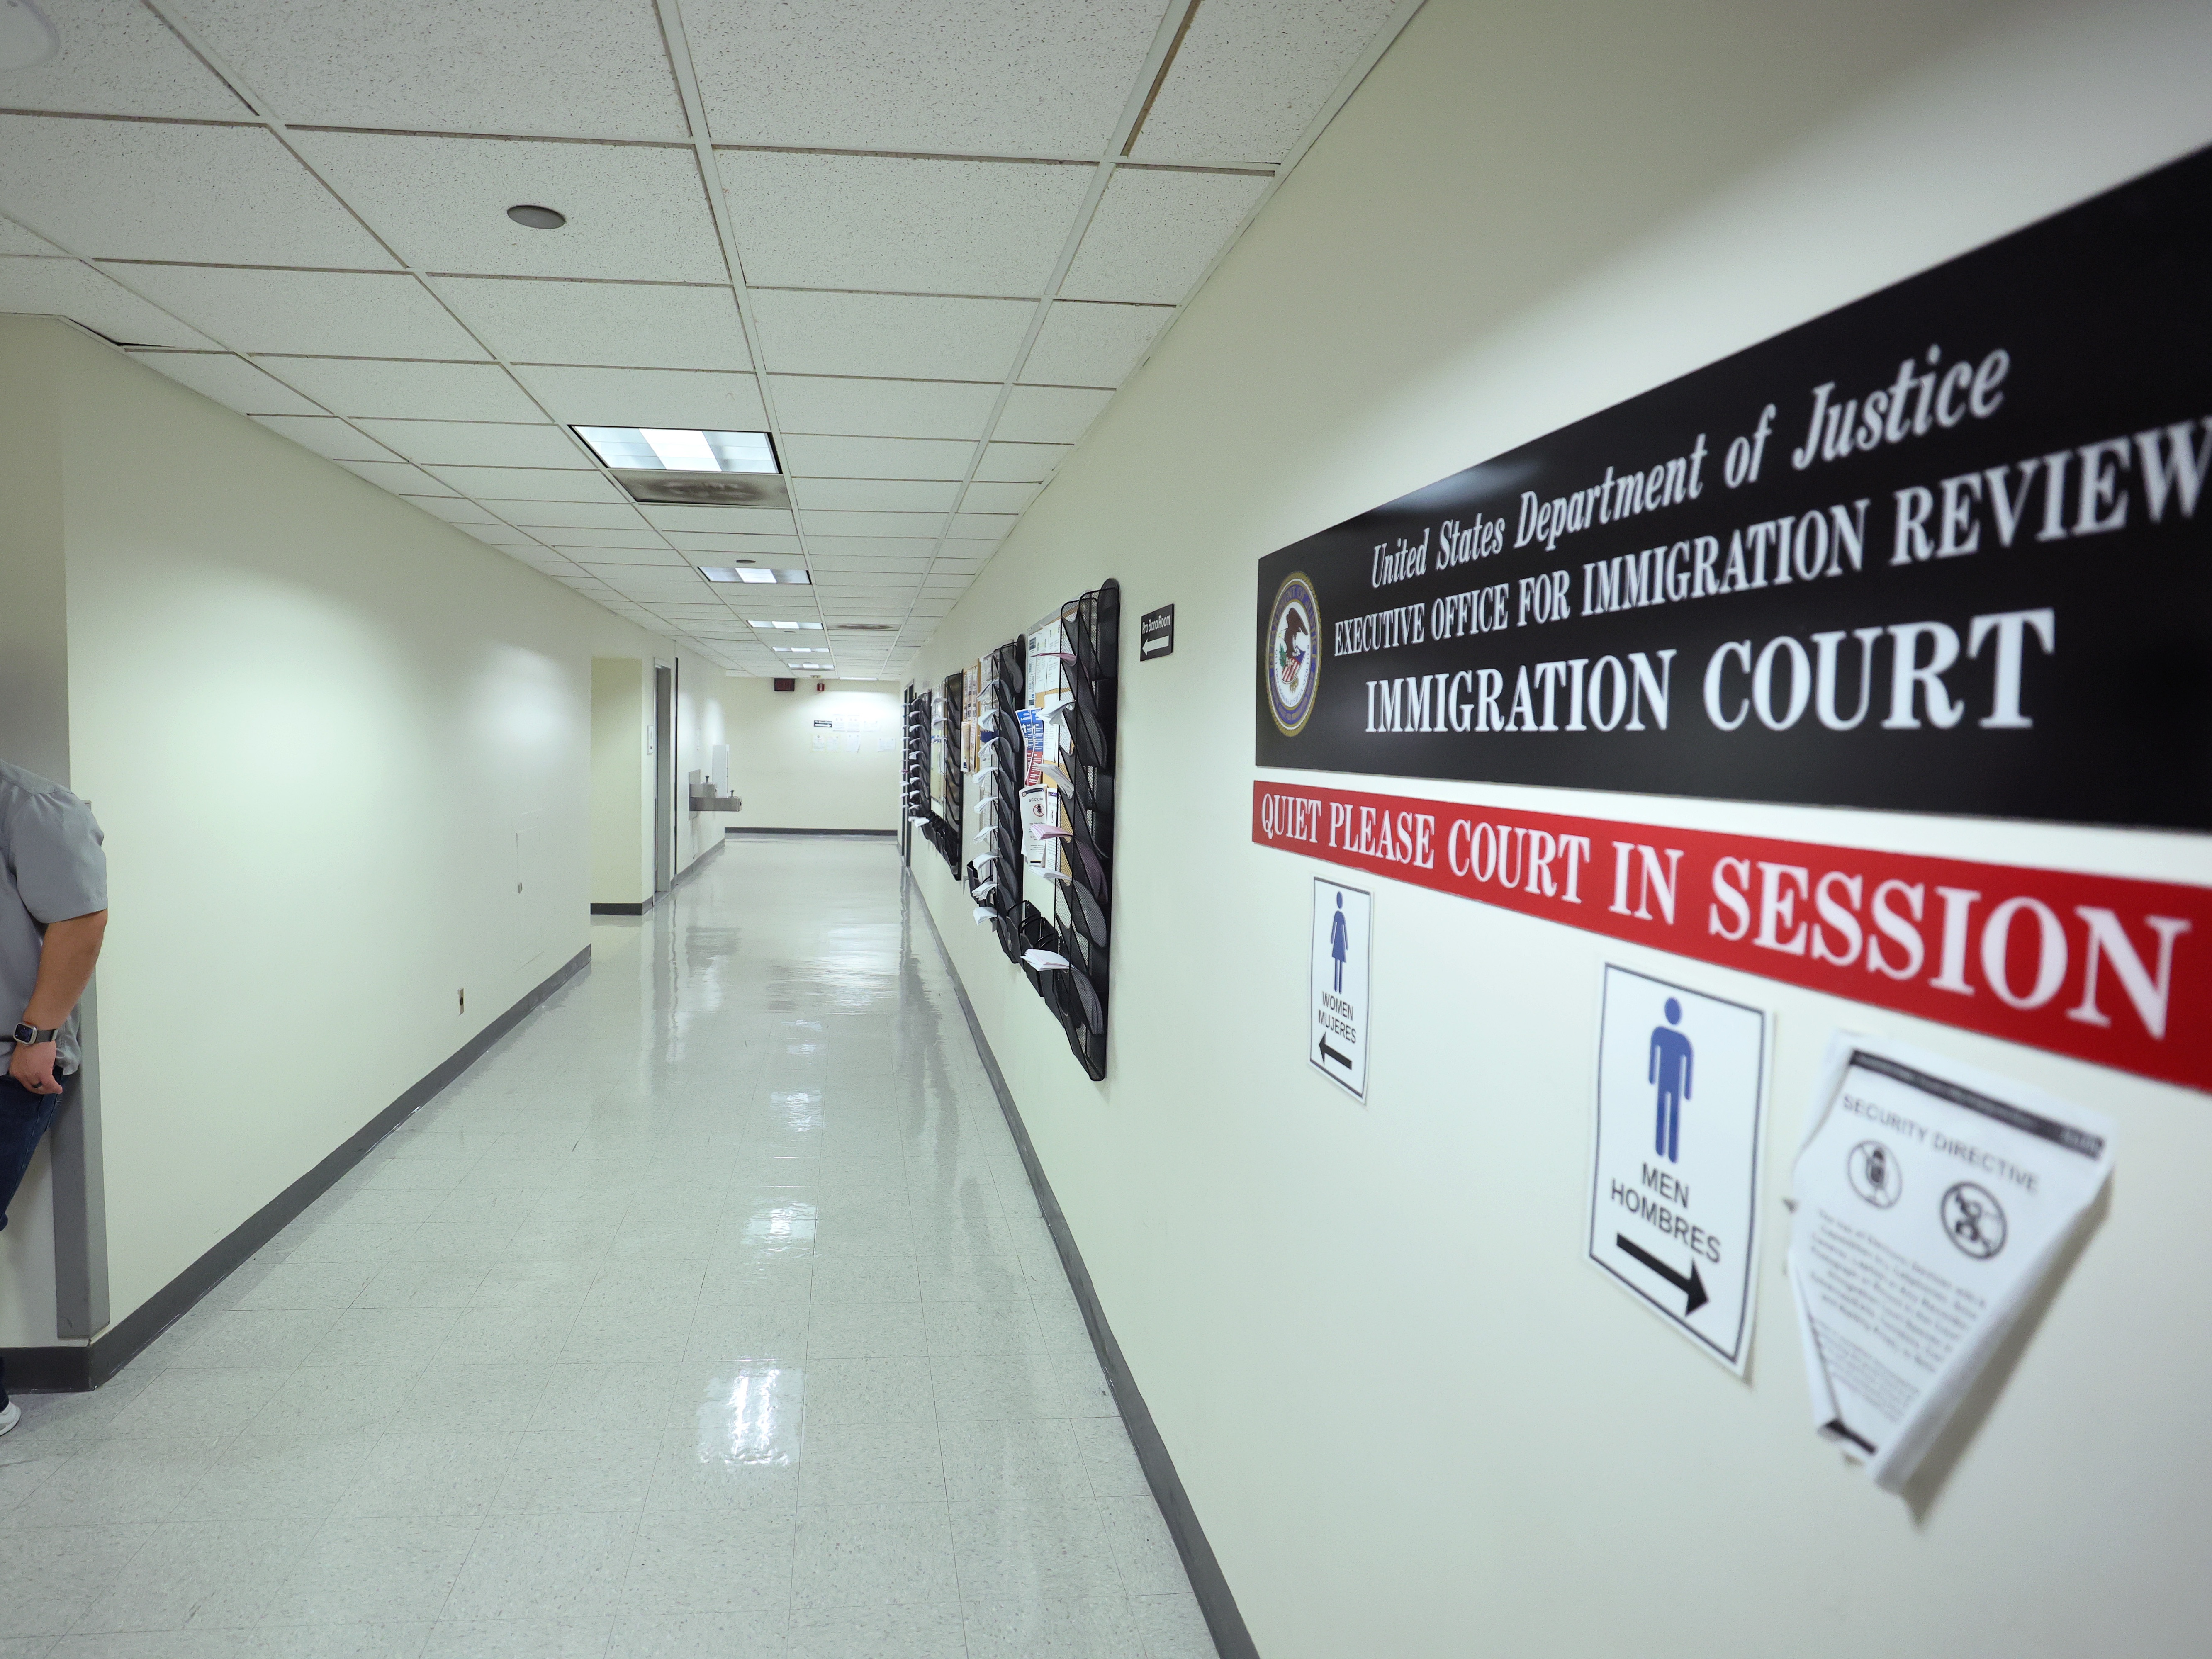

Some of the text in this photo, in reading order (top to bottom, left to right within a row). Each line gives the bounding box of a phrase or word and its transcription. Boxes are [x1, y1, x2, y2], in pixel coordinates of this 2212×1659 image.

[1372, 344, 2010, 589] United States Department of Justice
[1334, 417, 2212, 657] EXECUTIVE OFFICE FOR IMMIGRATION REVIEW
[1148, 619, 1158, 632] Bono
[1158, 615, 1171, 629] Room
[1364, 648, 1677, 733] IMMIGRATION
[1702, 608, 2055, 732] COURT
[1261, 792, 2189, 1039] QUIET PLEASE COURT IN SESSION
[1319, 1009, 1357, 1044] MUJERES
[1322, 990, 1354, 1022] WOMEN
[1641, 1160, 1690, 1210] MEN
[1842, 1093, 1929, 1143] SECURITY
[1933, 1130, 2039, 1194] DIRECTIVE
[1611, 1177, 1721, 1264] HOMBRES
